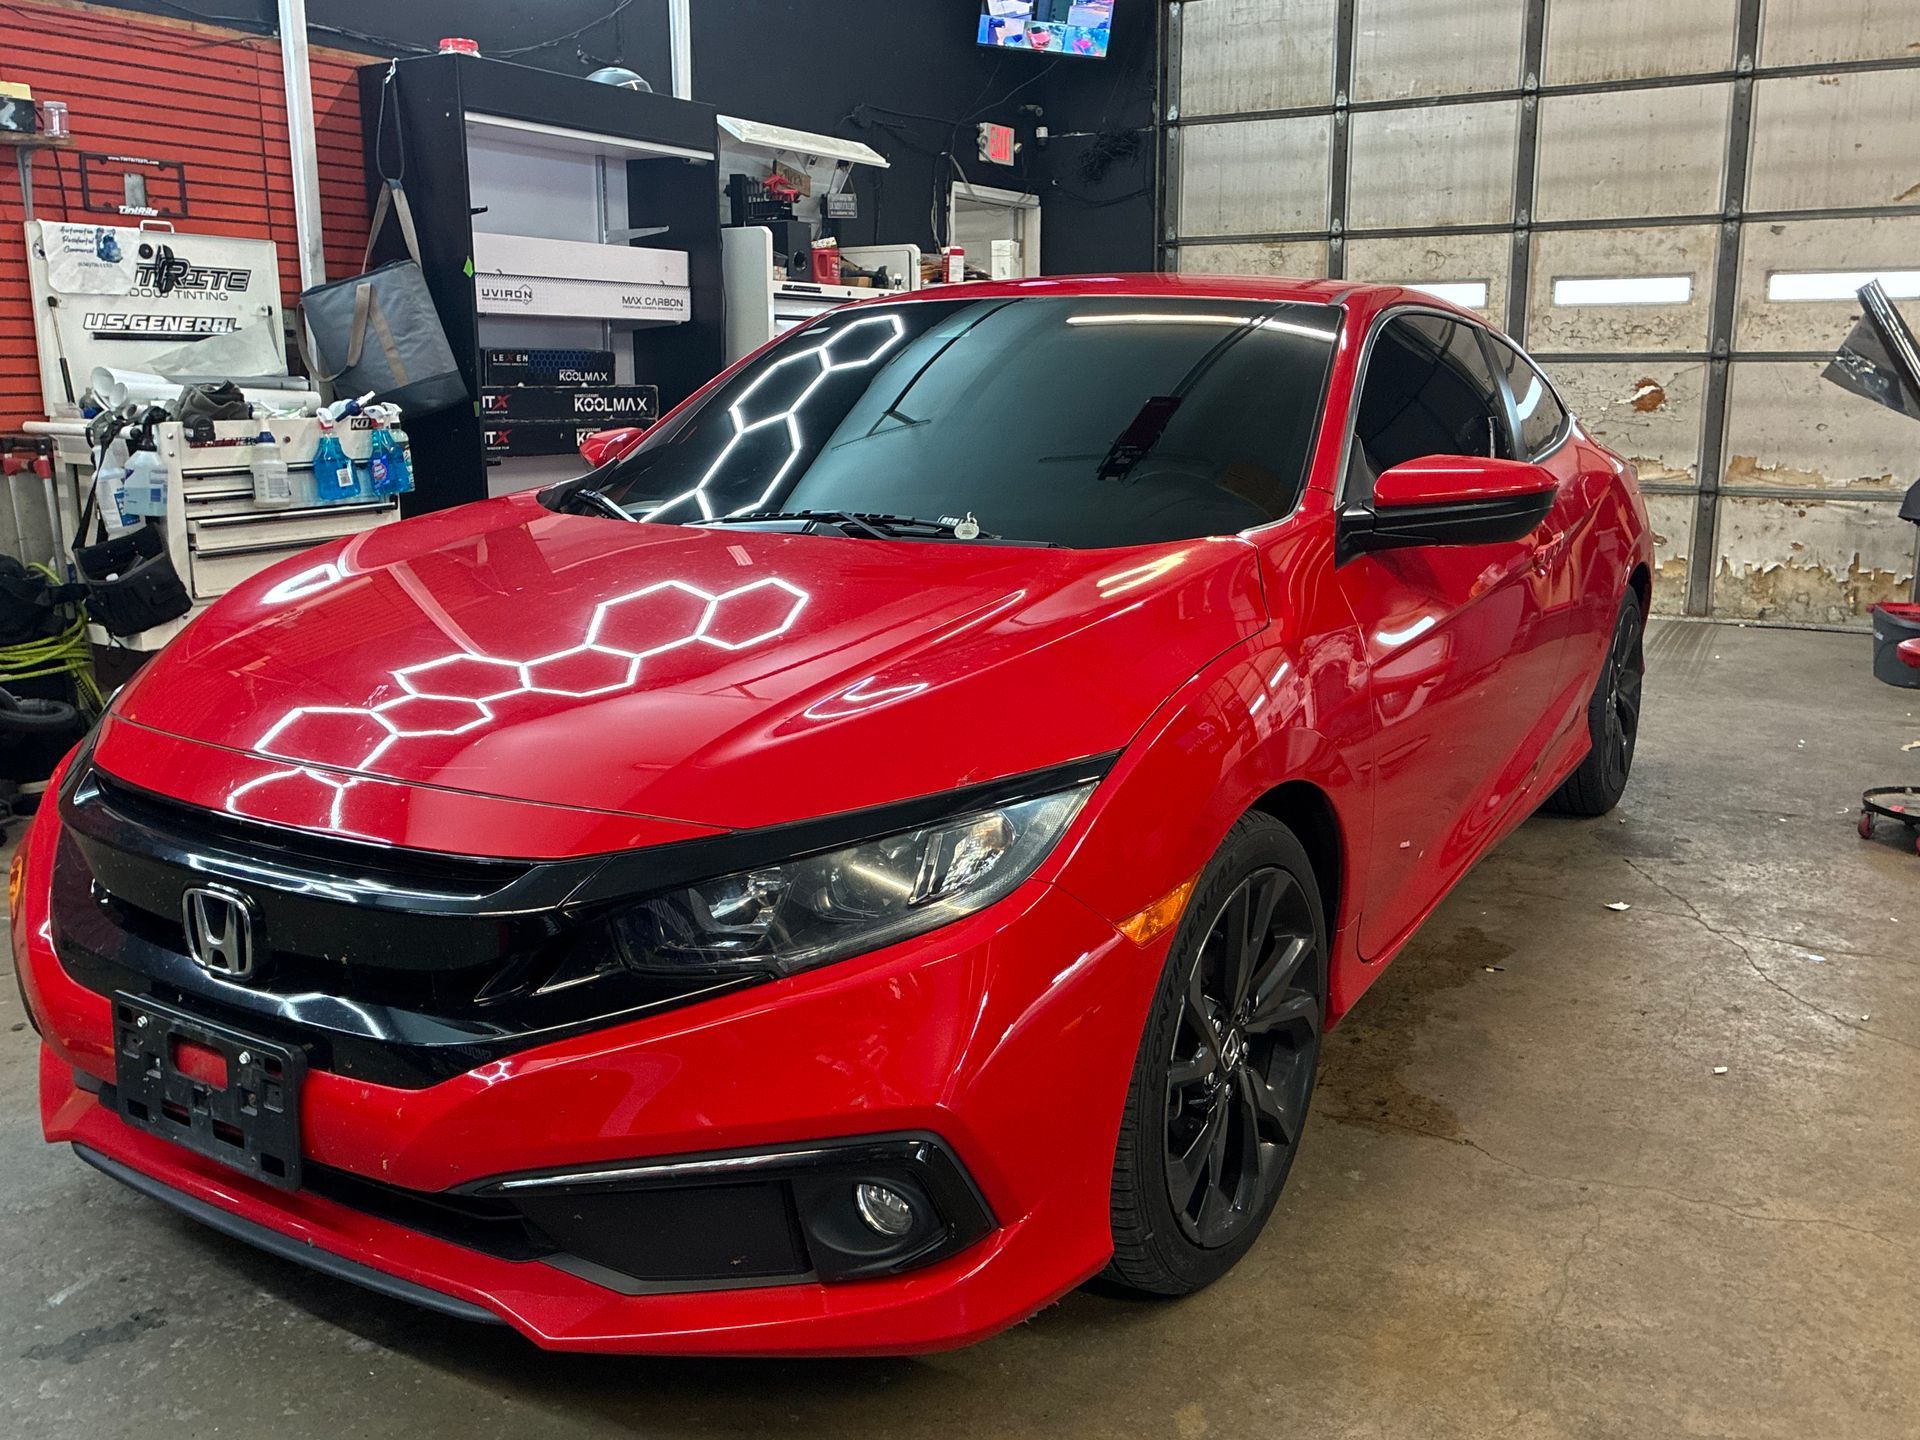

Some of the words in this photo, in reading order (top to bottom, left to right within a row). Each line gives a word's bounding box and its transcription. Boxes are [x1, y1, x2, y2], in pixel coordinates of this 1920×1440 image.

[990, 128, 1011, 161] EXIT
[118, 205, 159, 217] TintRite
[173, 289, 229, 301] TINTING
[481, 288, 532, 299] UVIRON
[621, 296, 642, 305] MAX
[644, 297, 684, 307] CARBON
[492, 353, 529, 362] LEXEN
[558, 371, 608, 382] KOOLMAX
[482, 393, 512, 409] ITX
[574, 397, 648, 412] KOOLMAX
[484, 429, 512, 445] ITX
[1148, 853, 1236, 1087] CONTINENTAL
